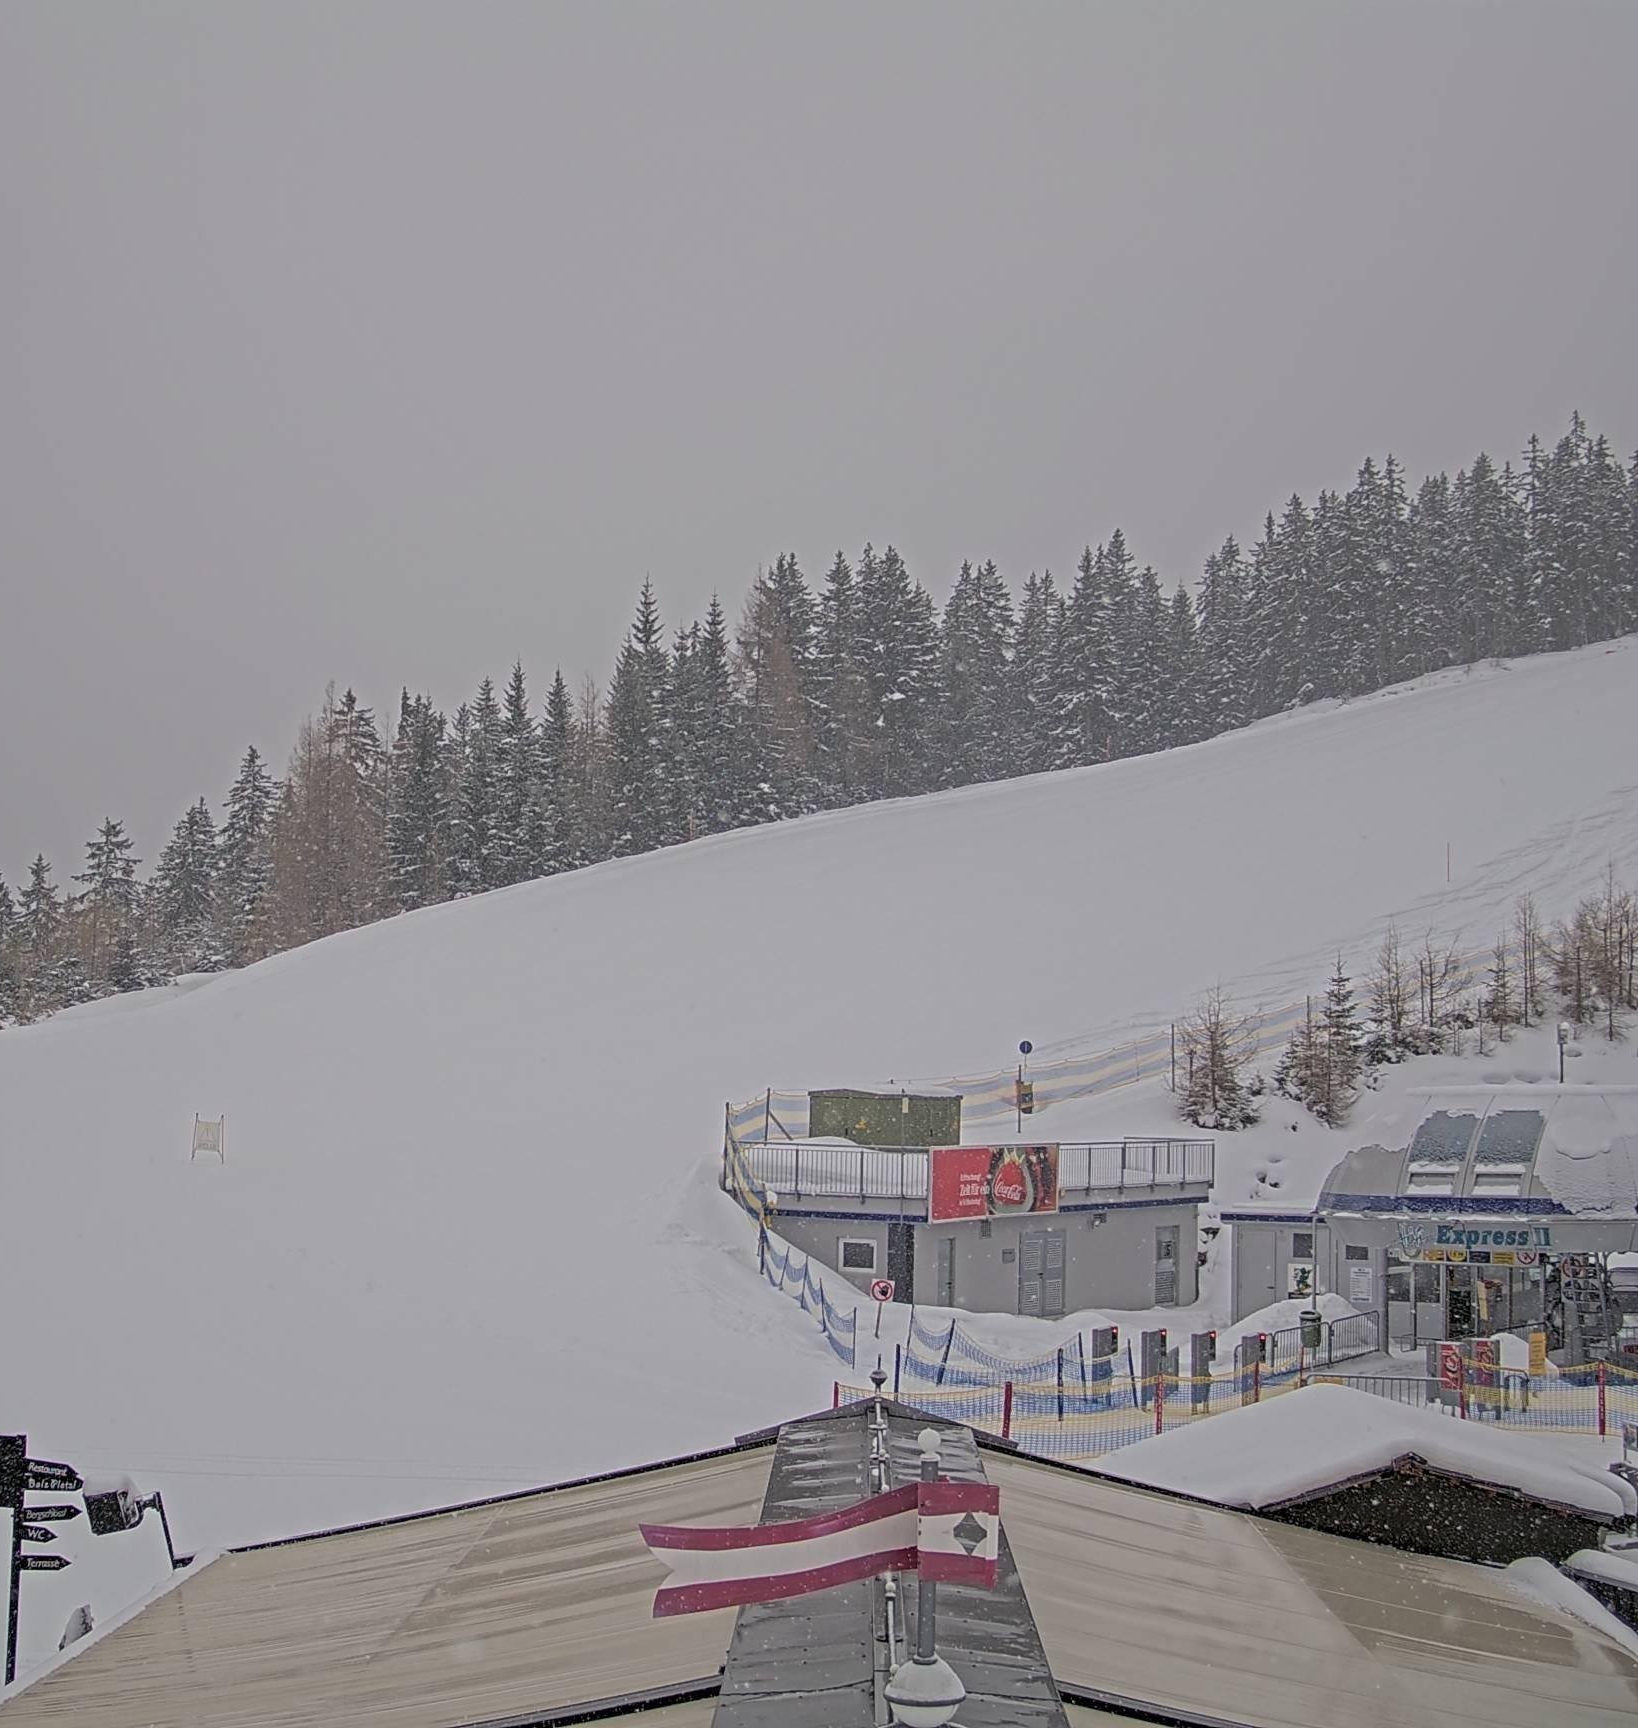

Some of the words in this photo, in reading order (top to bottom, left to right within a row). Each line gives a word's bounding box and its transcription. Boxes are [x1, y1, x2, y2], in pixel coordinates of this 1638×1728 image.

[1437, 1225, 1529, 1249] Express
[1533, 1227, 1552, 1246] II
[28, 1528, 45, 1539] WC
[27, 1558, 60, 1568] Terrasse
